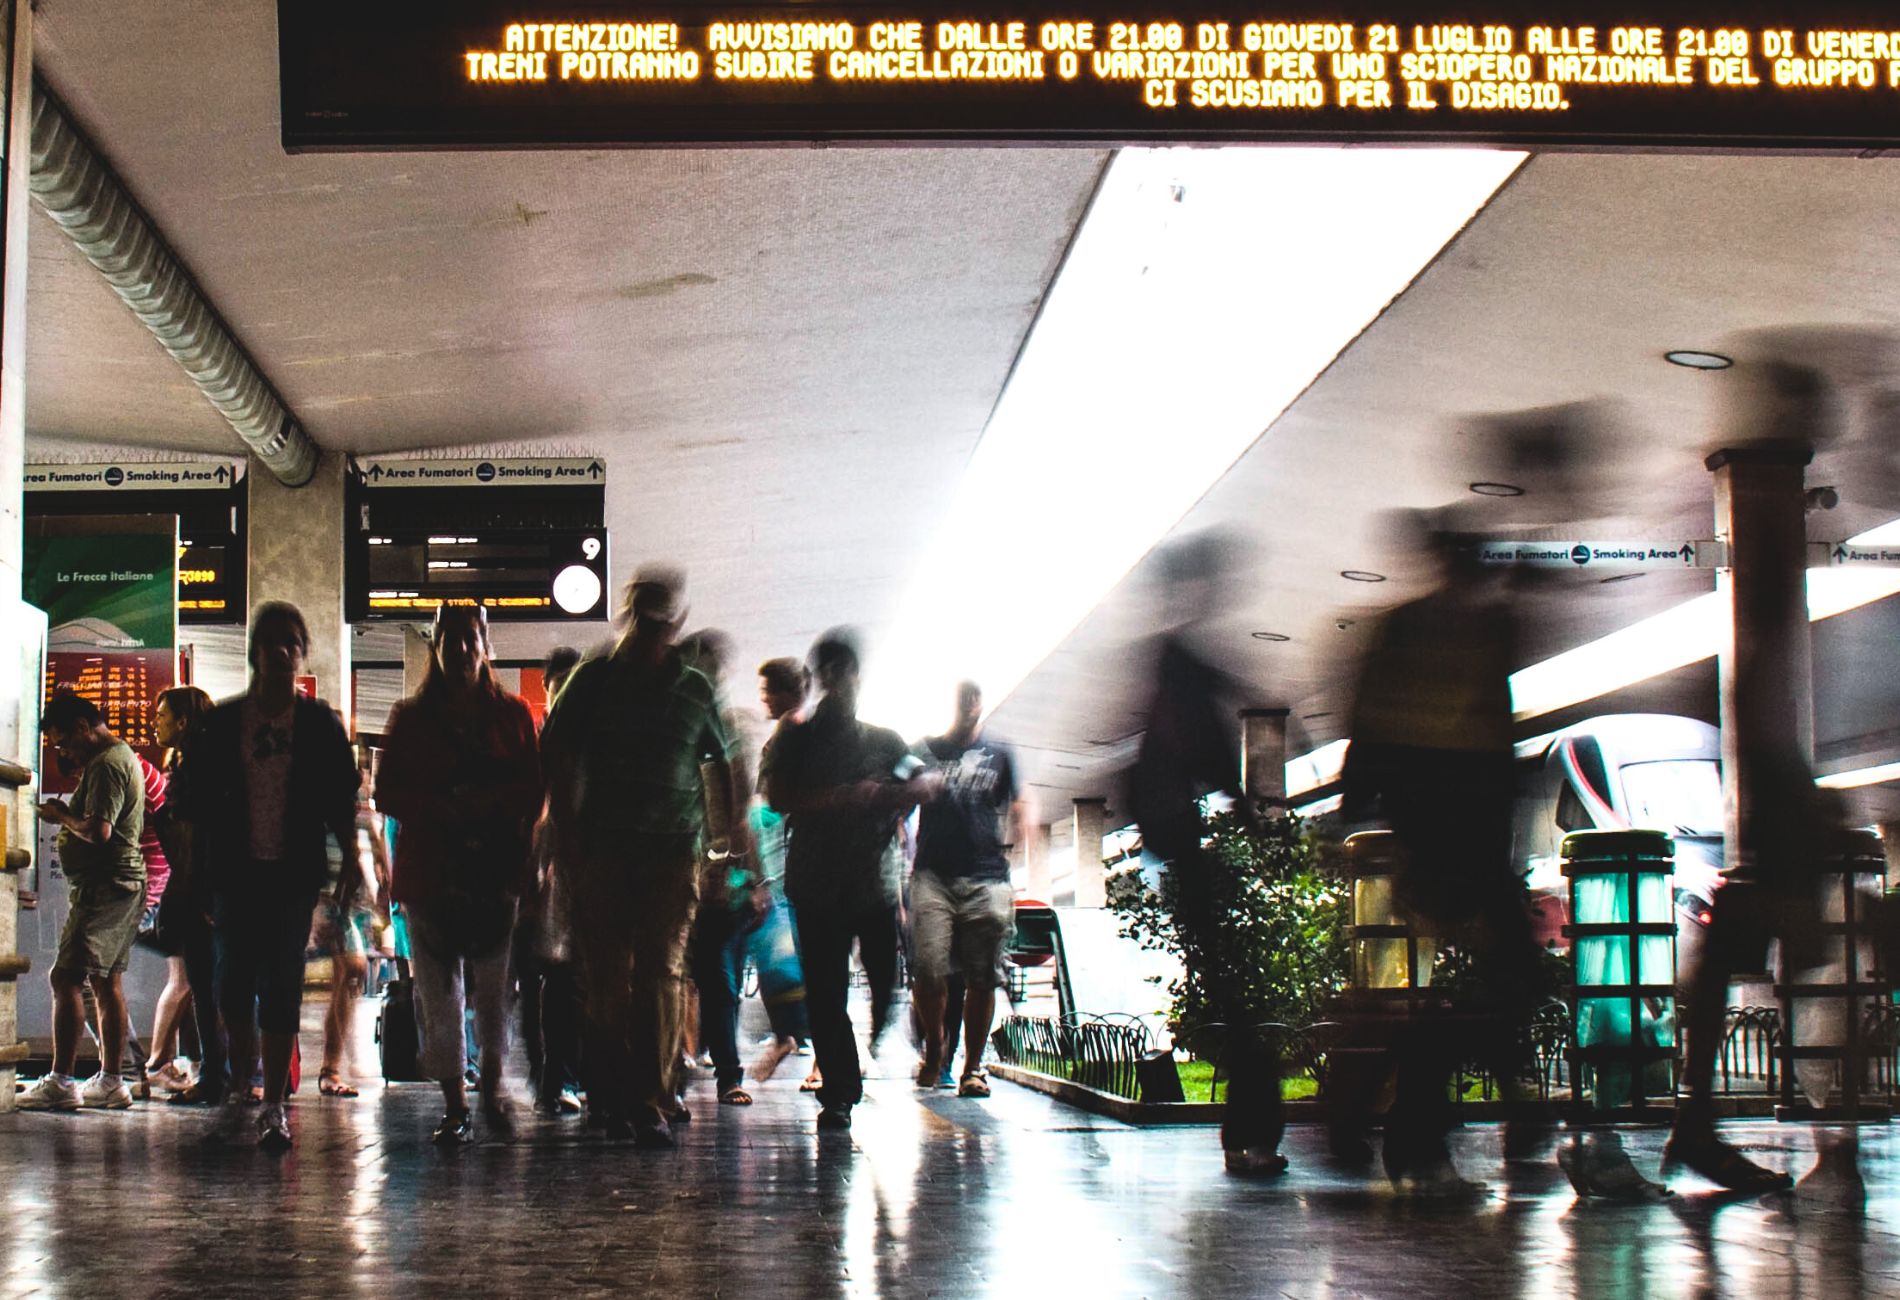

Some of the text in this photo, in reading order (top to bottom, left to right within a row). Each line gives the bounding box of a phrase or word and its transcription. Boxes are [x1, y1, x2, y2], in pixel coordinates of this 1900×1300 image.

[506, 23, 678, 51] ATTENZIONE!
[709, 23, 854, 51] AVVISIAMO
[869, 23, 922, 50] CHE
[939, 23, 1025, 50] DALLE
[1042, 23, 1093, 50] ORE
[1110, 23, 1182, 51] 21.00
[1198, 24, 1229, 51] DI
[1244, 24, 1354, 52] GIOVEDI
[1369, 25, 1399, 52] 21
[1415, 26, 1512, 54] LUGLIO
[1528, 27, 1595, 54] ALLE
[1612, 28, 1662, 55] ORE
[1679, 29, 1748, 56] 21.00
[1764, 31, 1793, 57] DI
[466, 53, 546, 80] TRENI
[562, 52, 698, 79] POTRANNO
[715, 52, 813, 78] SUBIRE
[830, 52, 1044, 79] CANCELLAZIONI
[1059, 52, 1077, 78] O
[1094, 52, 1249, 79] VARIAZIONI
[1264, 53, 1316, 79] PER
[1332, 54, 1385, 80] UNO
[1401, 55, 1531, 81] SCIOPERO
[1547, 56, 1693, 84] NAZIONALE
[1709, 57, 1759, 85] DEL
[1775, 58, 1874, 87] GRUPPO
[1146, 80, 1568, 109] CI SCUSIAMO PER IL DISAGIO.
[23, 471, 102, 483] rea Fumatori
[127, 470, 212, 482] Smoking Area
[386, 467, 473, 478] Area Fumatori
[498, 466, 585, 479] Smoking Area
[582, 538, 601, 560] 9
[1483, 549, 1569, 560] Area Fumatori
[1593, 549, 1678, 561] Smoking Area
[1849, 550, 1878, 560] Area
[57, 571, 154, 582] Le Frecce Italiane
